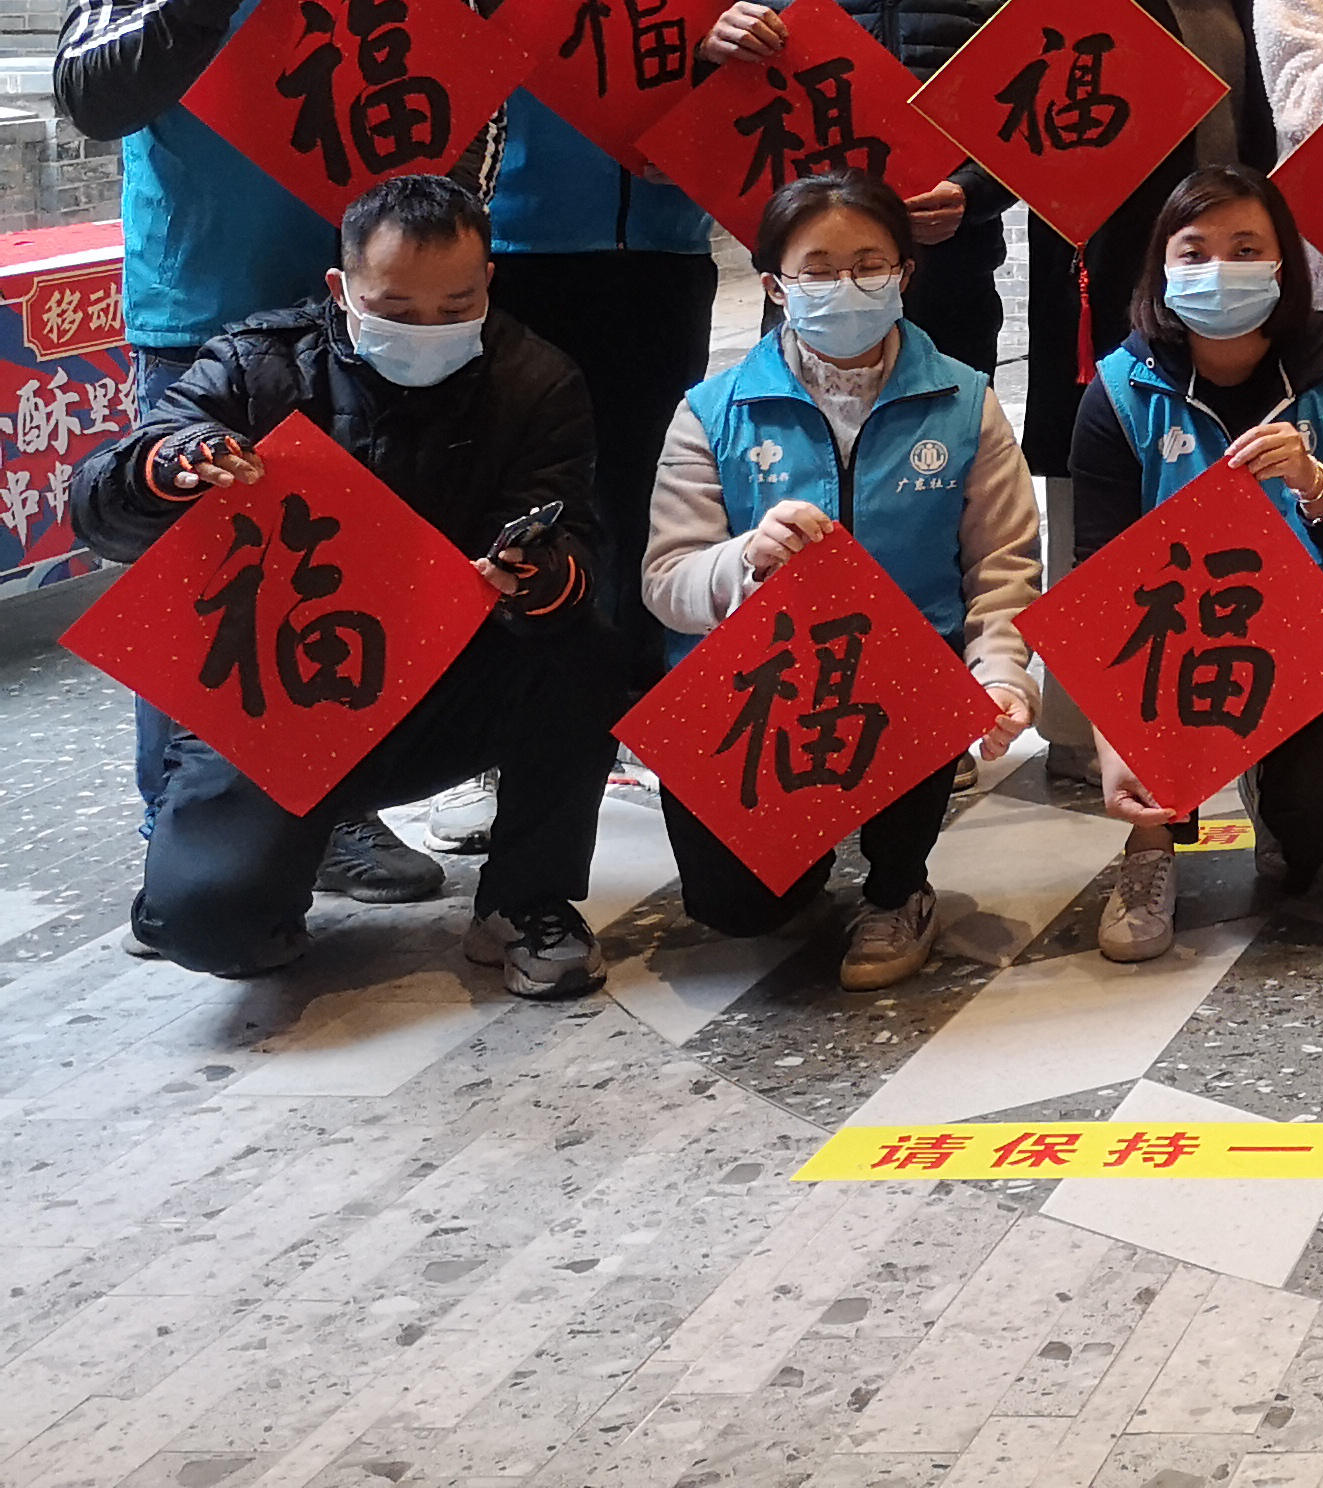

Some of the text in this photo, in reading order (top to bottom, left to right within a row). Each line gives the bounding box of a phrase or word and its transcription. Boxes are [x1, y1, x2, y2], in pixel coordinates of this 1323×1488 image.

[736, 57, 890, 197] 福
[995, 28, 1130, 156] 福
[194, 493, 386, 718] 福
[1111, 543, 1275, 738] 福
[715, 612, 889, 809] 福
